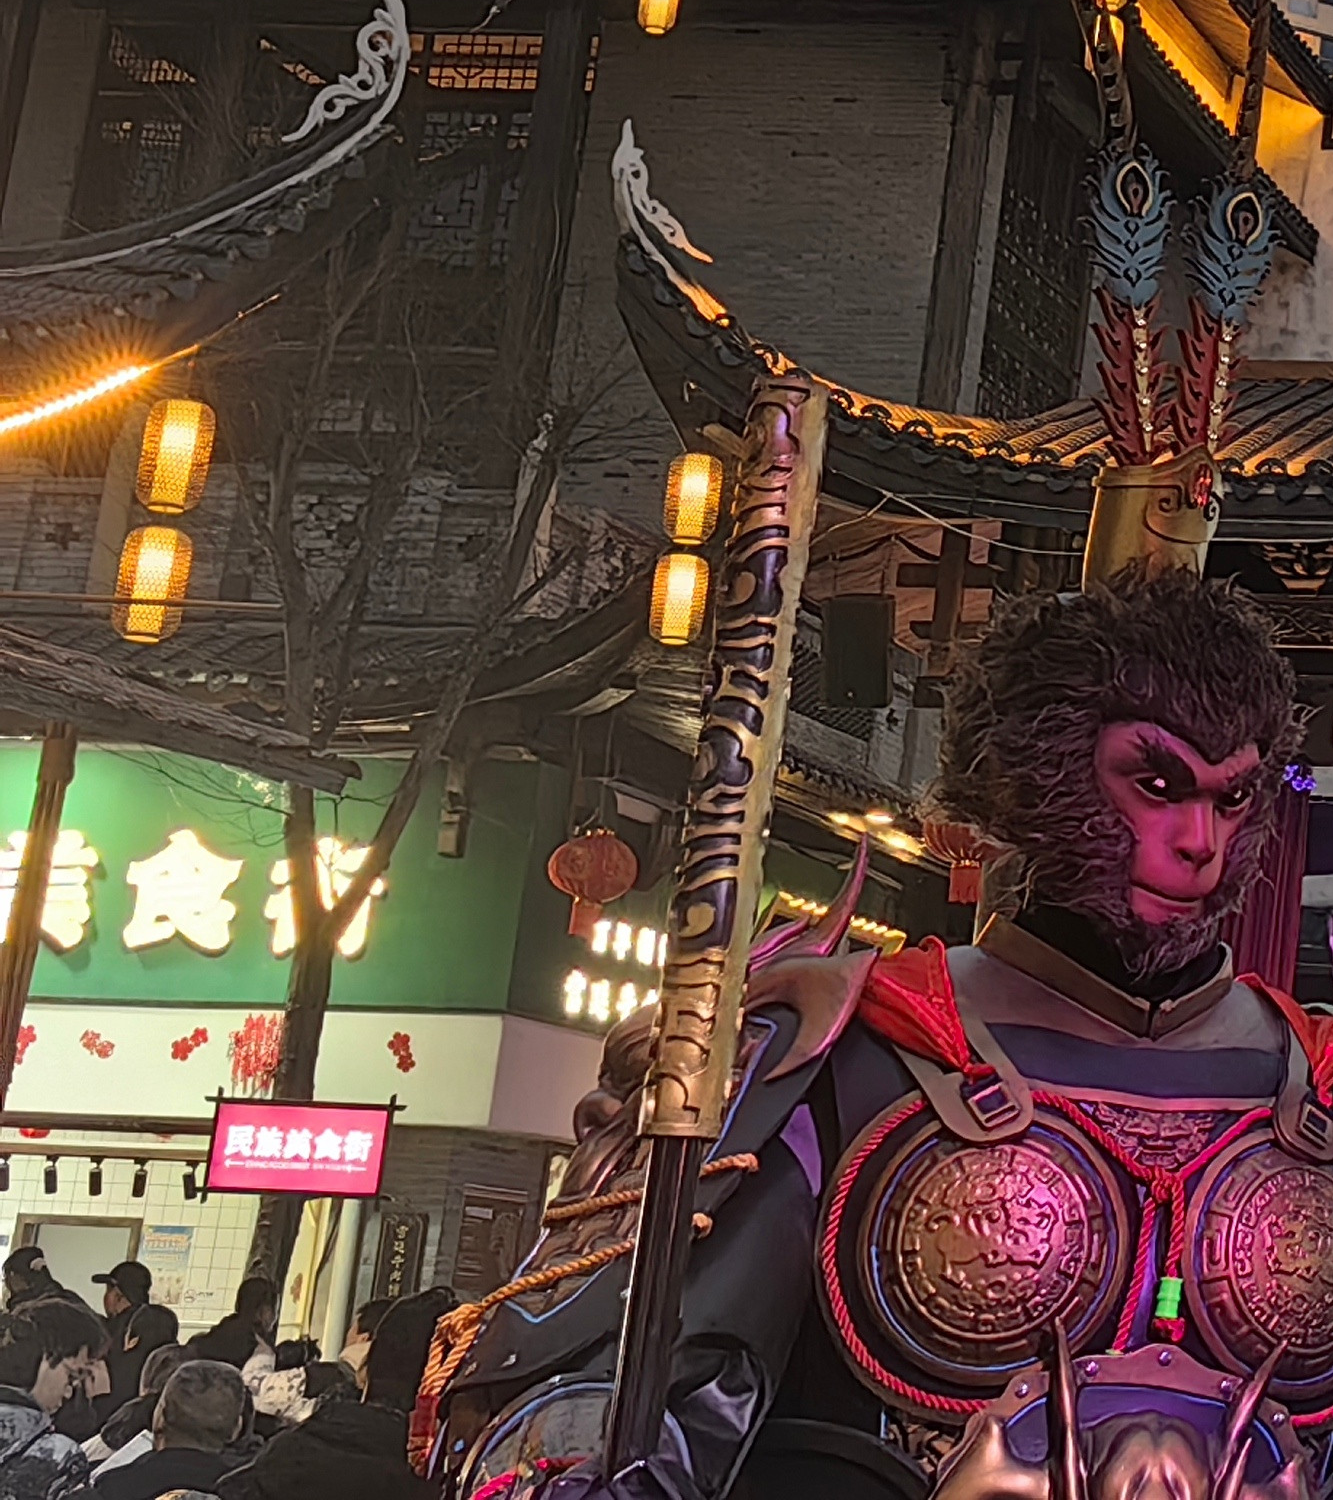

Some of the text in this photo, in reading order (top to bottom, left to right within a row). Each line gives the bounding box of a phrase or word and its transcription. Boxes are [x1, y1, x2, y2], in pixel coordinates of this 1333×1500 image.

[224, 1124, 374, 1162] 民族美食街
